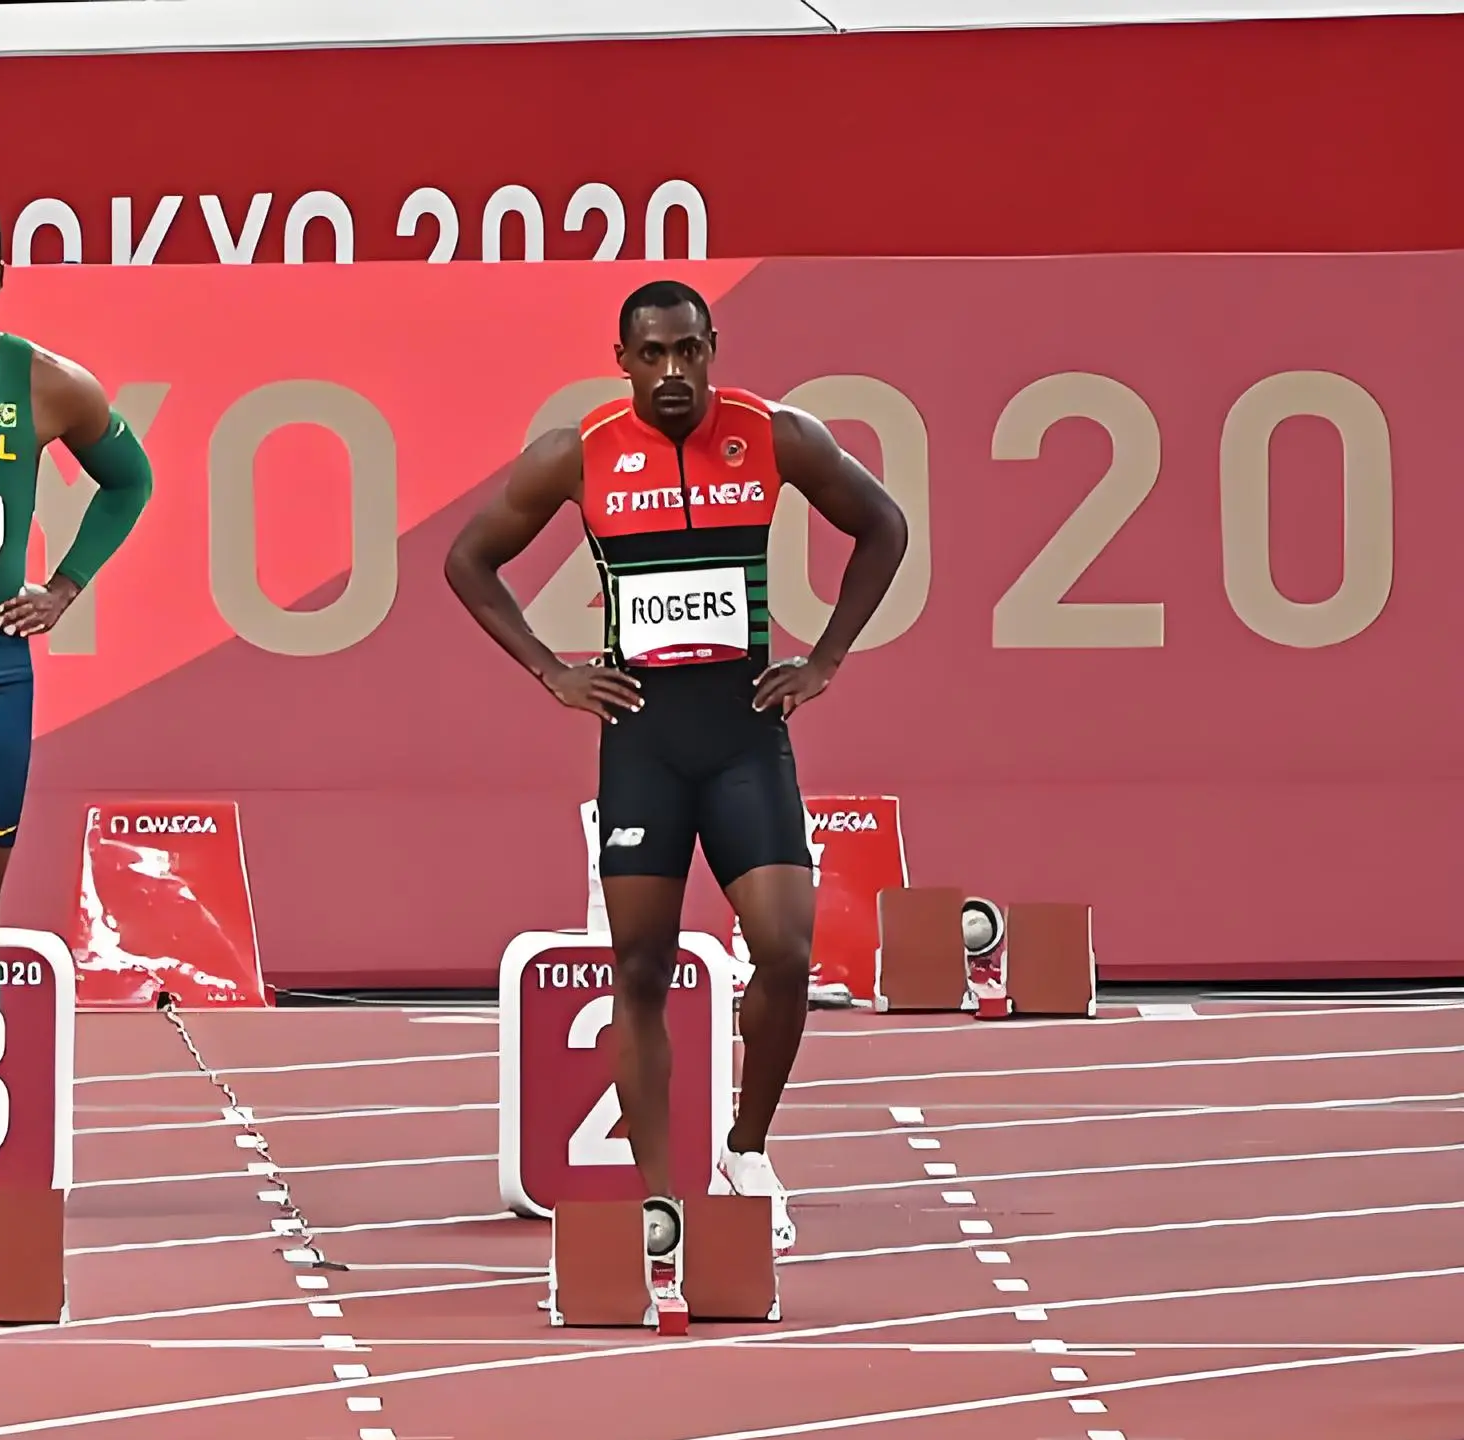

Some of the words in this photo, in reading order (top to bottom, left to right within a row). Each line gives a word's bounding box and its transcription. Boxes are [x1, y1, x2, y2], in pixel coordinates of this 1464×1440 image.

[396, 179, 707, 264] 2020
[632, 591, 736, 624] ROGERS
[536, 963, 613, 989] TOKY
